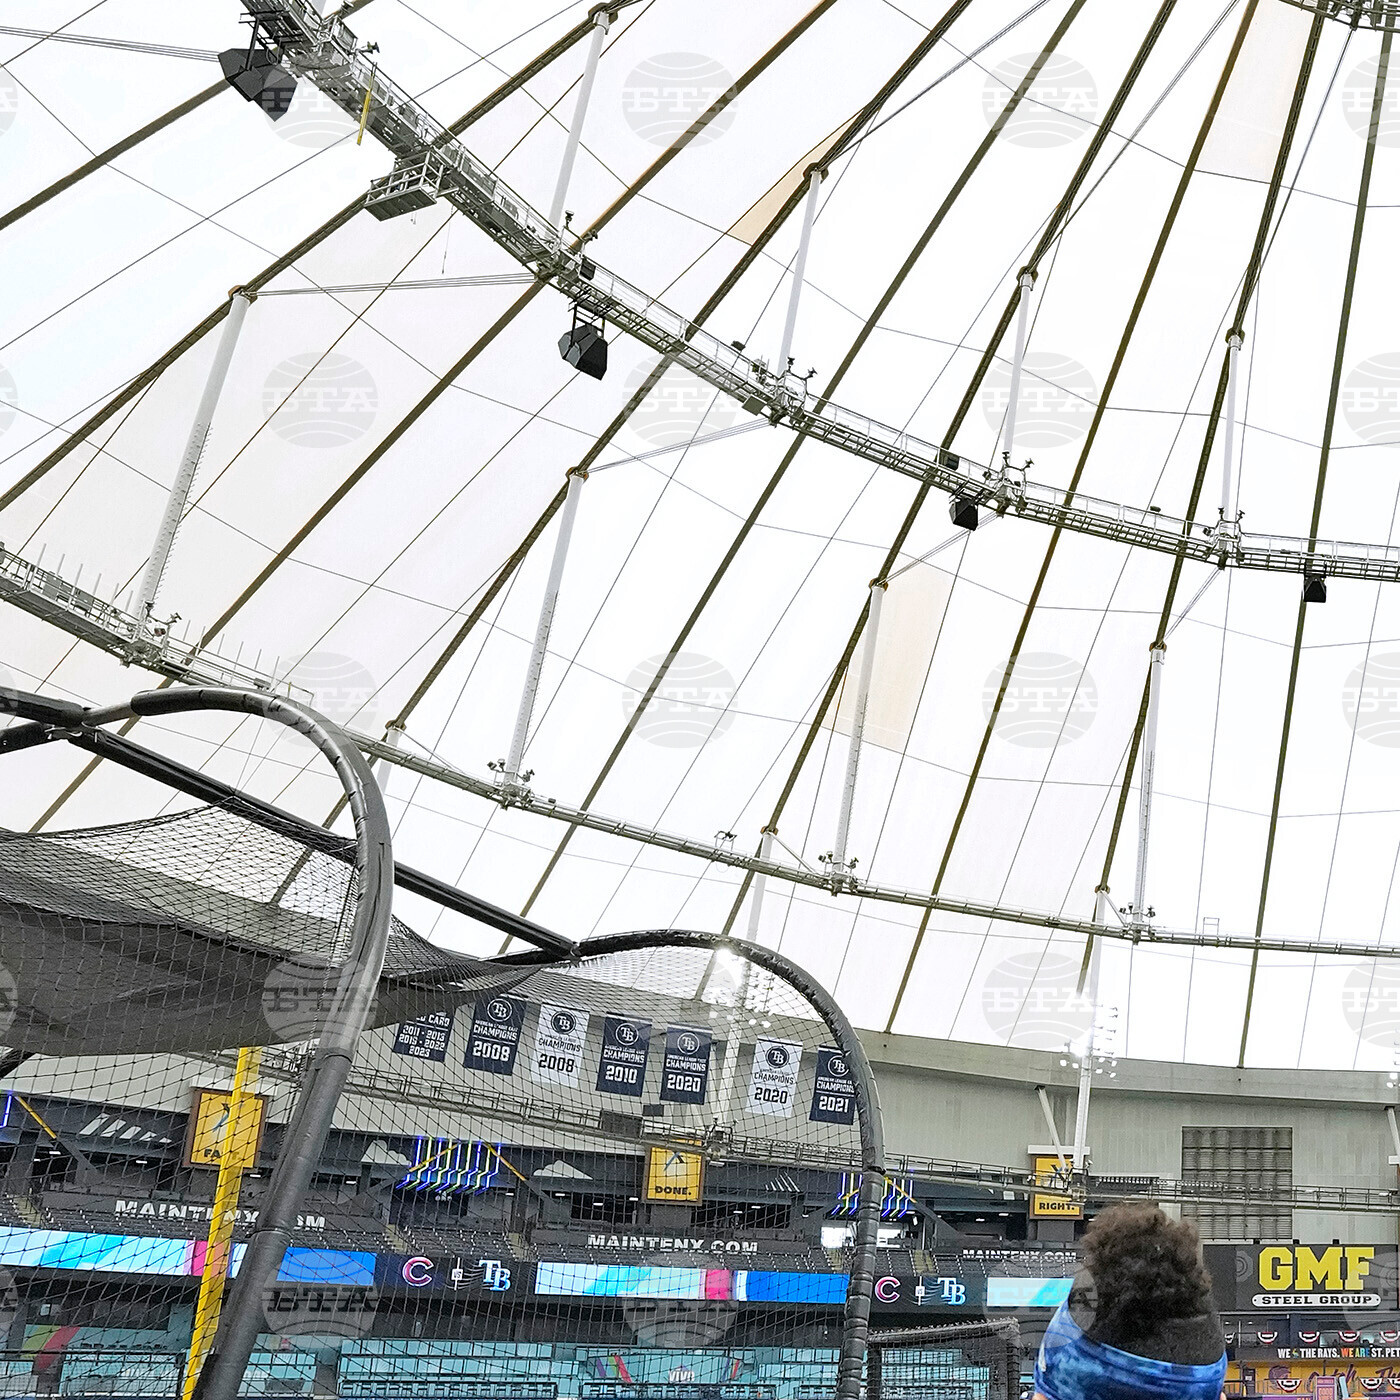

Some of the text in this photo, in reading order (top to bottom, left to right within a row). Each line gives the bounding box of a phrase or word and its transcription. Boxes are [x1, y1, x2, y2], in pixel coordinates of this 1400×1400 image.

[473, 1025, 518, 1041] CHAMPIONS
[472, 1041, 511, 1062] 2008
[538, 1038, 581, 1052] CHAMPIONS
[539, 1054, 575, 1073] 2008
[603, 1049, 645, 1064] CHAMPIONS
[666, 1058, 706, 1072] CHAMPIONS
[605, 1065, 638, 1084] 2010
[754, 1072, 794, 1085] CHAMPIONS
[667, 1074, 700, 1092] 2020
[754, 1087, 788, 1104] 2020
[818, 1096, 850, 1113] 2021
[654, 1185, 692, 1197] DONE.
[1038, 1202, 1075, 1212] RIGHT.
[587, 1234, 759, 1256] MAINTENX.COM
[962, 1249, 1077, 1263] MAINTENX.COM
[478, 1259, 512, 1292] TB
[1258, 1246, 1375, 1291] GMF
[936, 1276, 966, 1306] TB
[1261, 1296, 1373, 1306] STEEL GROUP
[1278, 1348, 1291, 1359] WE
[1300, 1348, 1317, 1358] THE
[1318, 1348, 1340, 1358] RAYS.
[1340, 1348, 1354, 1358] WE
[1354, 1348, 1370, 1358] ARE
